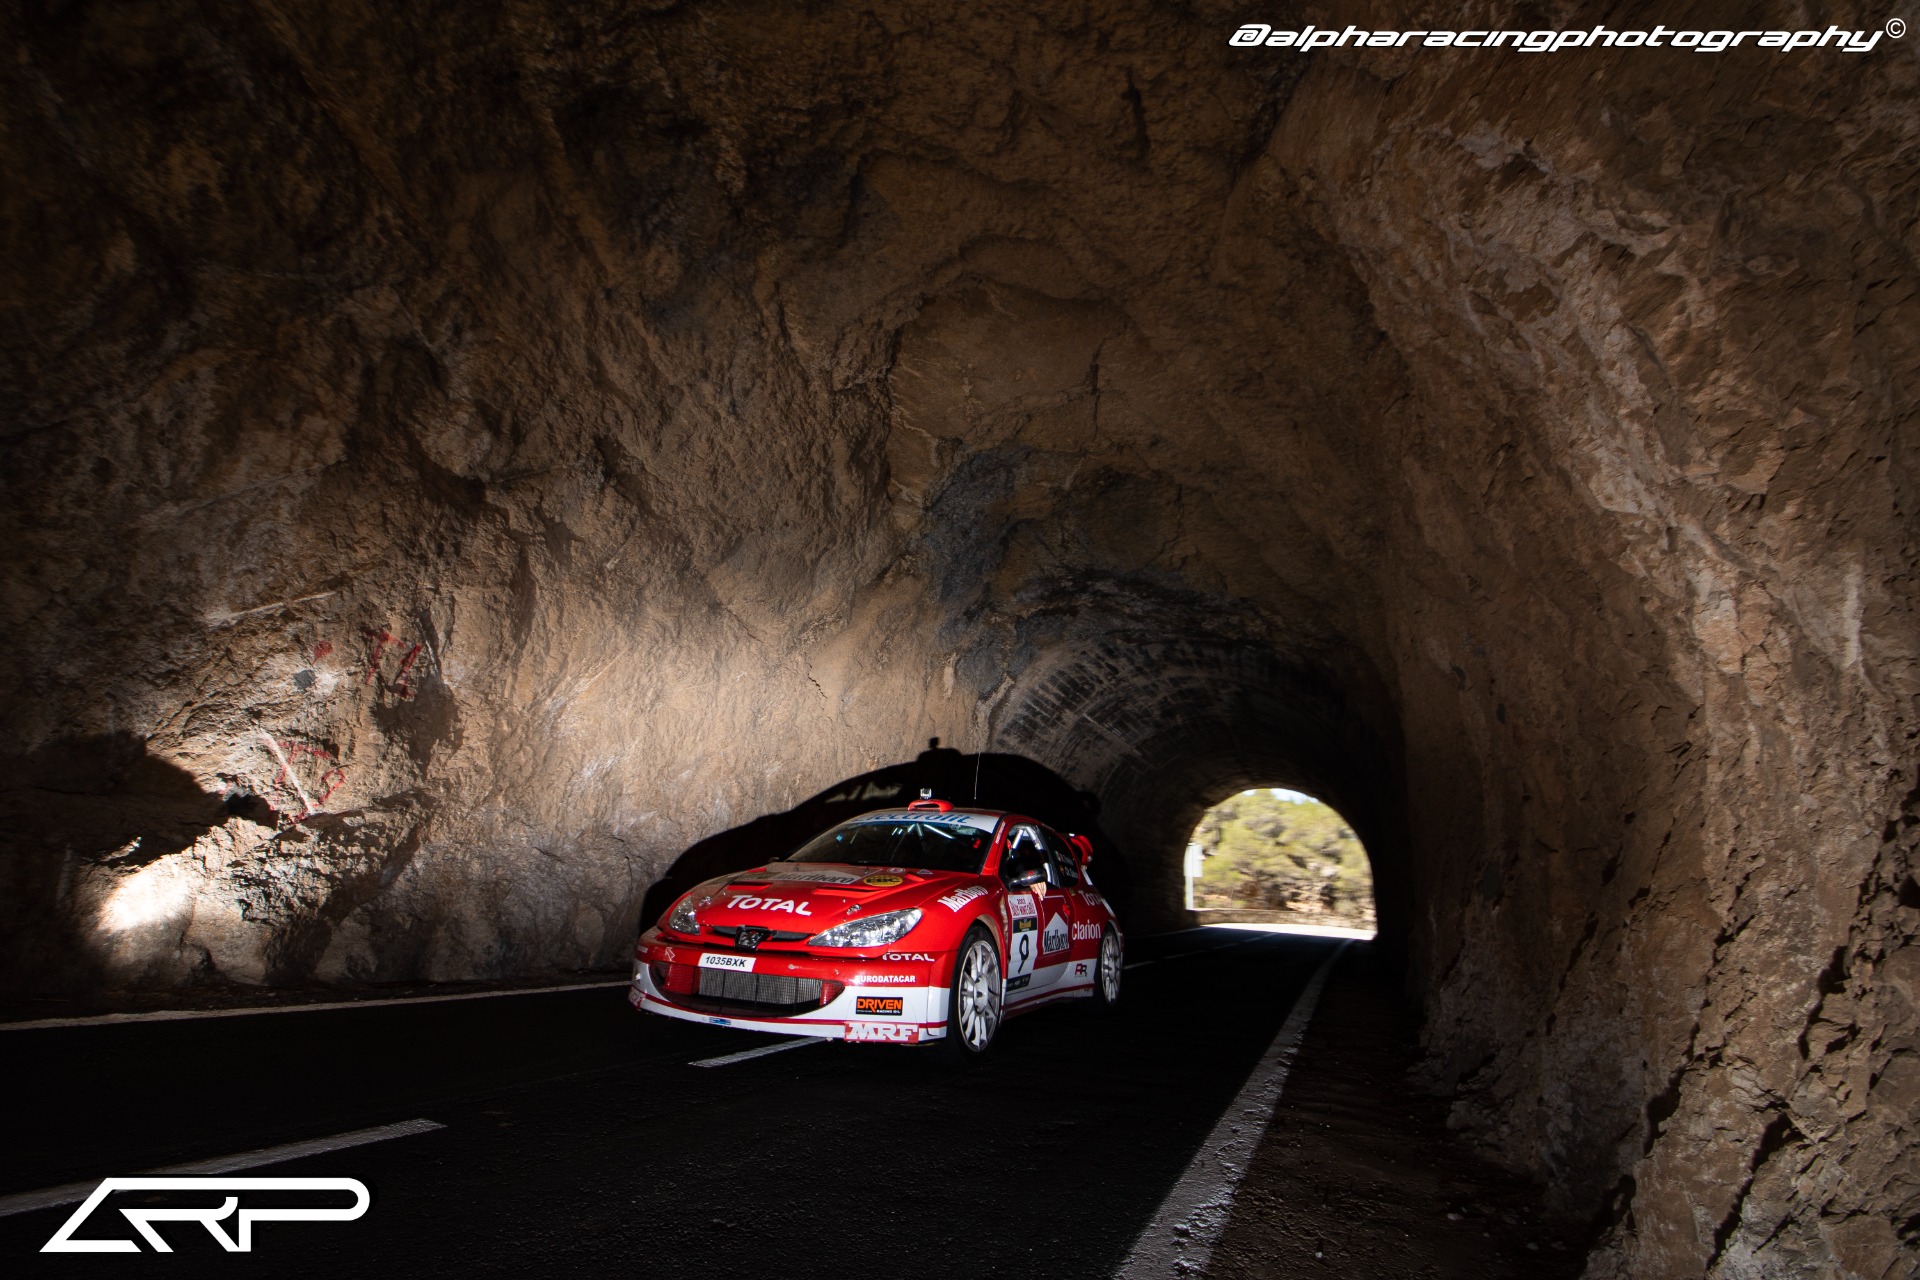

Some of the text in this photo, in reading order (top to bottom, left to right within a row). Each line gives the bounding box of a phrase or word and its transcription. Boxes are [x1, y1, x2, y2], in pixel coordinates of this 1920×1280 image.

[727, 894, 813, 916] TOTAL
[882, 952, 935, 962] TOTAL
[1018, 933, 1030, 974] 9
[705, 956, 747, 968] 1035BXK
[855, 975, 916, 983] EURODATACAR
[857, 998, 903, 1013] DRIVEN
[846, 1023, 919, 1041] MRF
